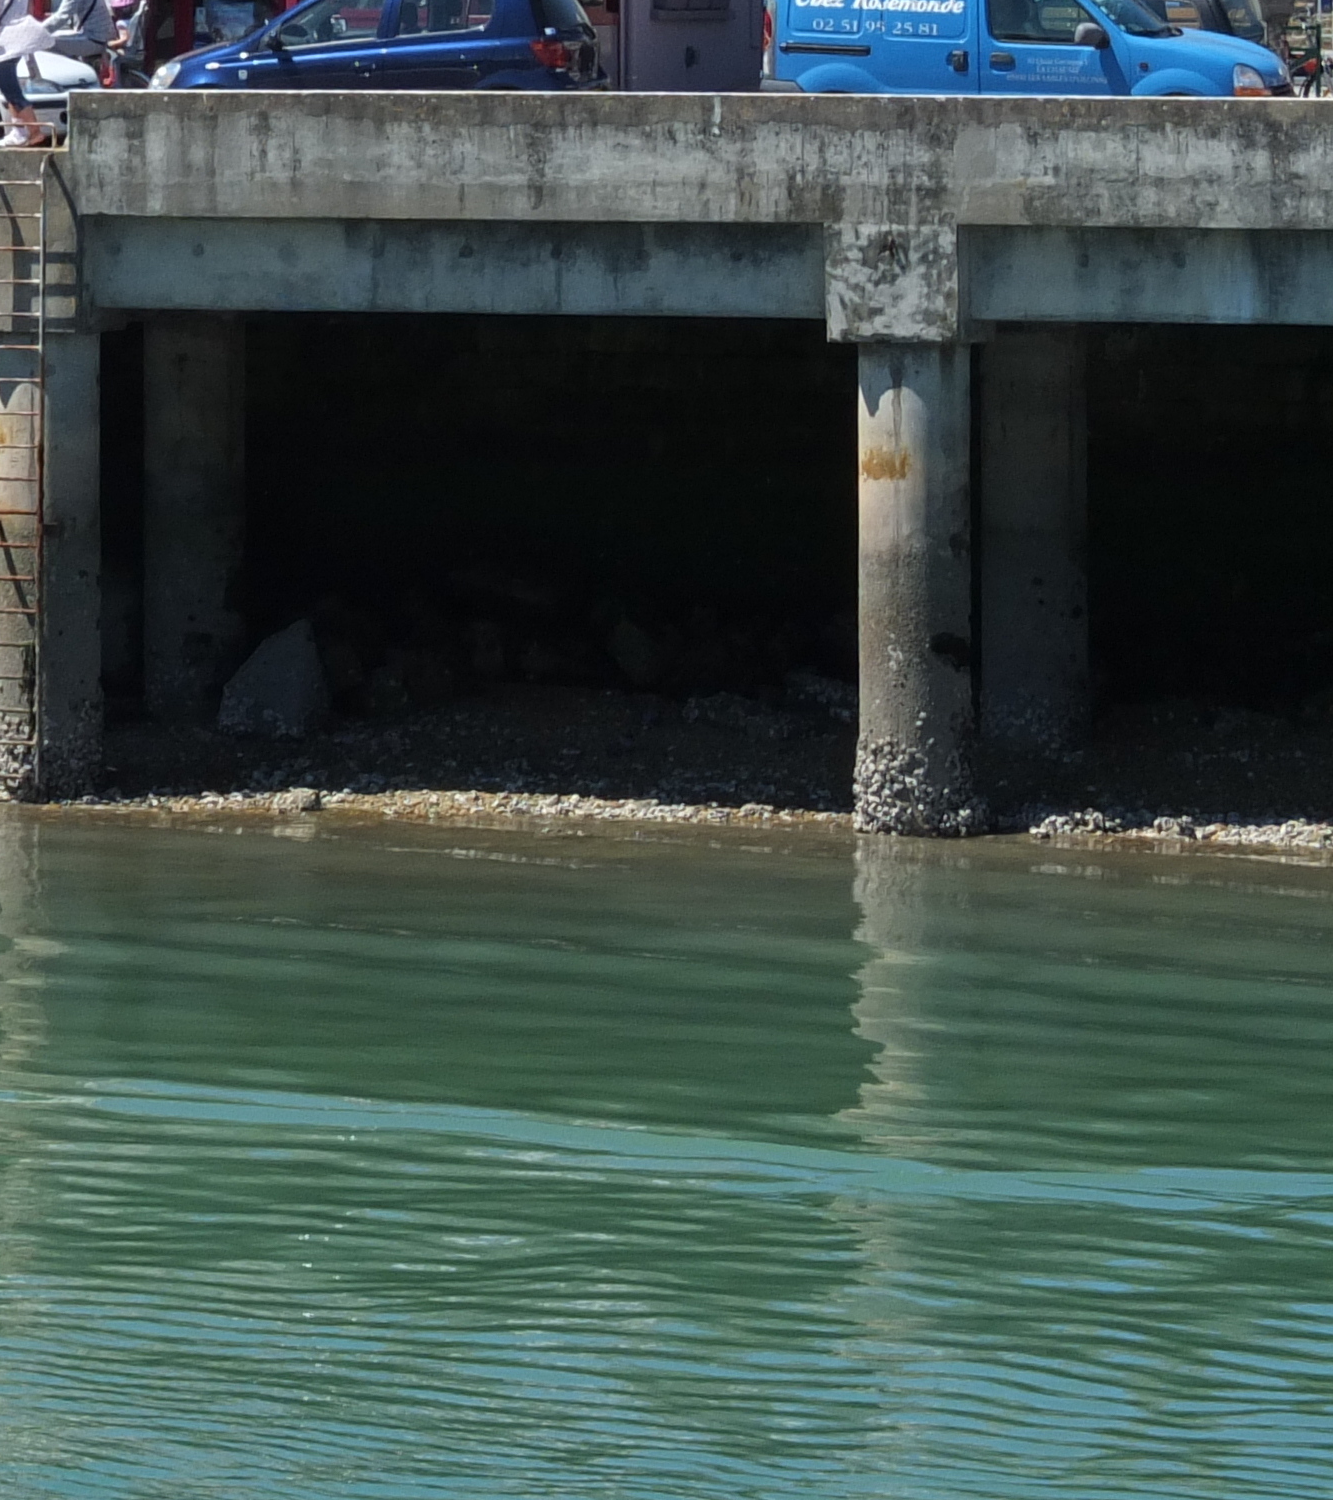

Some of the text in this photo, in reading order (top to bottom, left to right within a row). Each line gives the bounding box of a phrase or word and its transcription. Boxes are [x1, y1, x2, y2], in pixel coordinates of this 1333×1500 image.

[812, 18, 939, 36] 02 51 95 25 81
